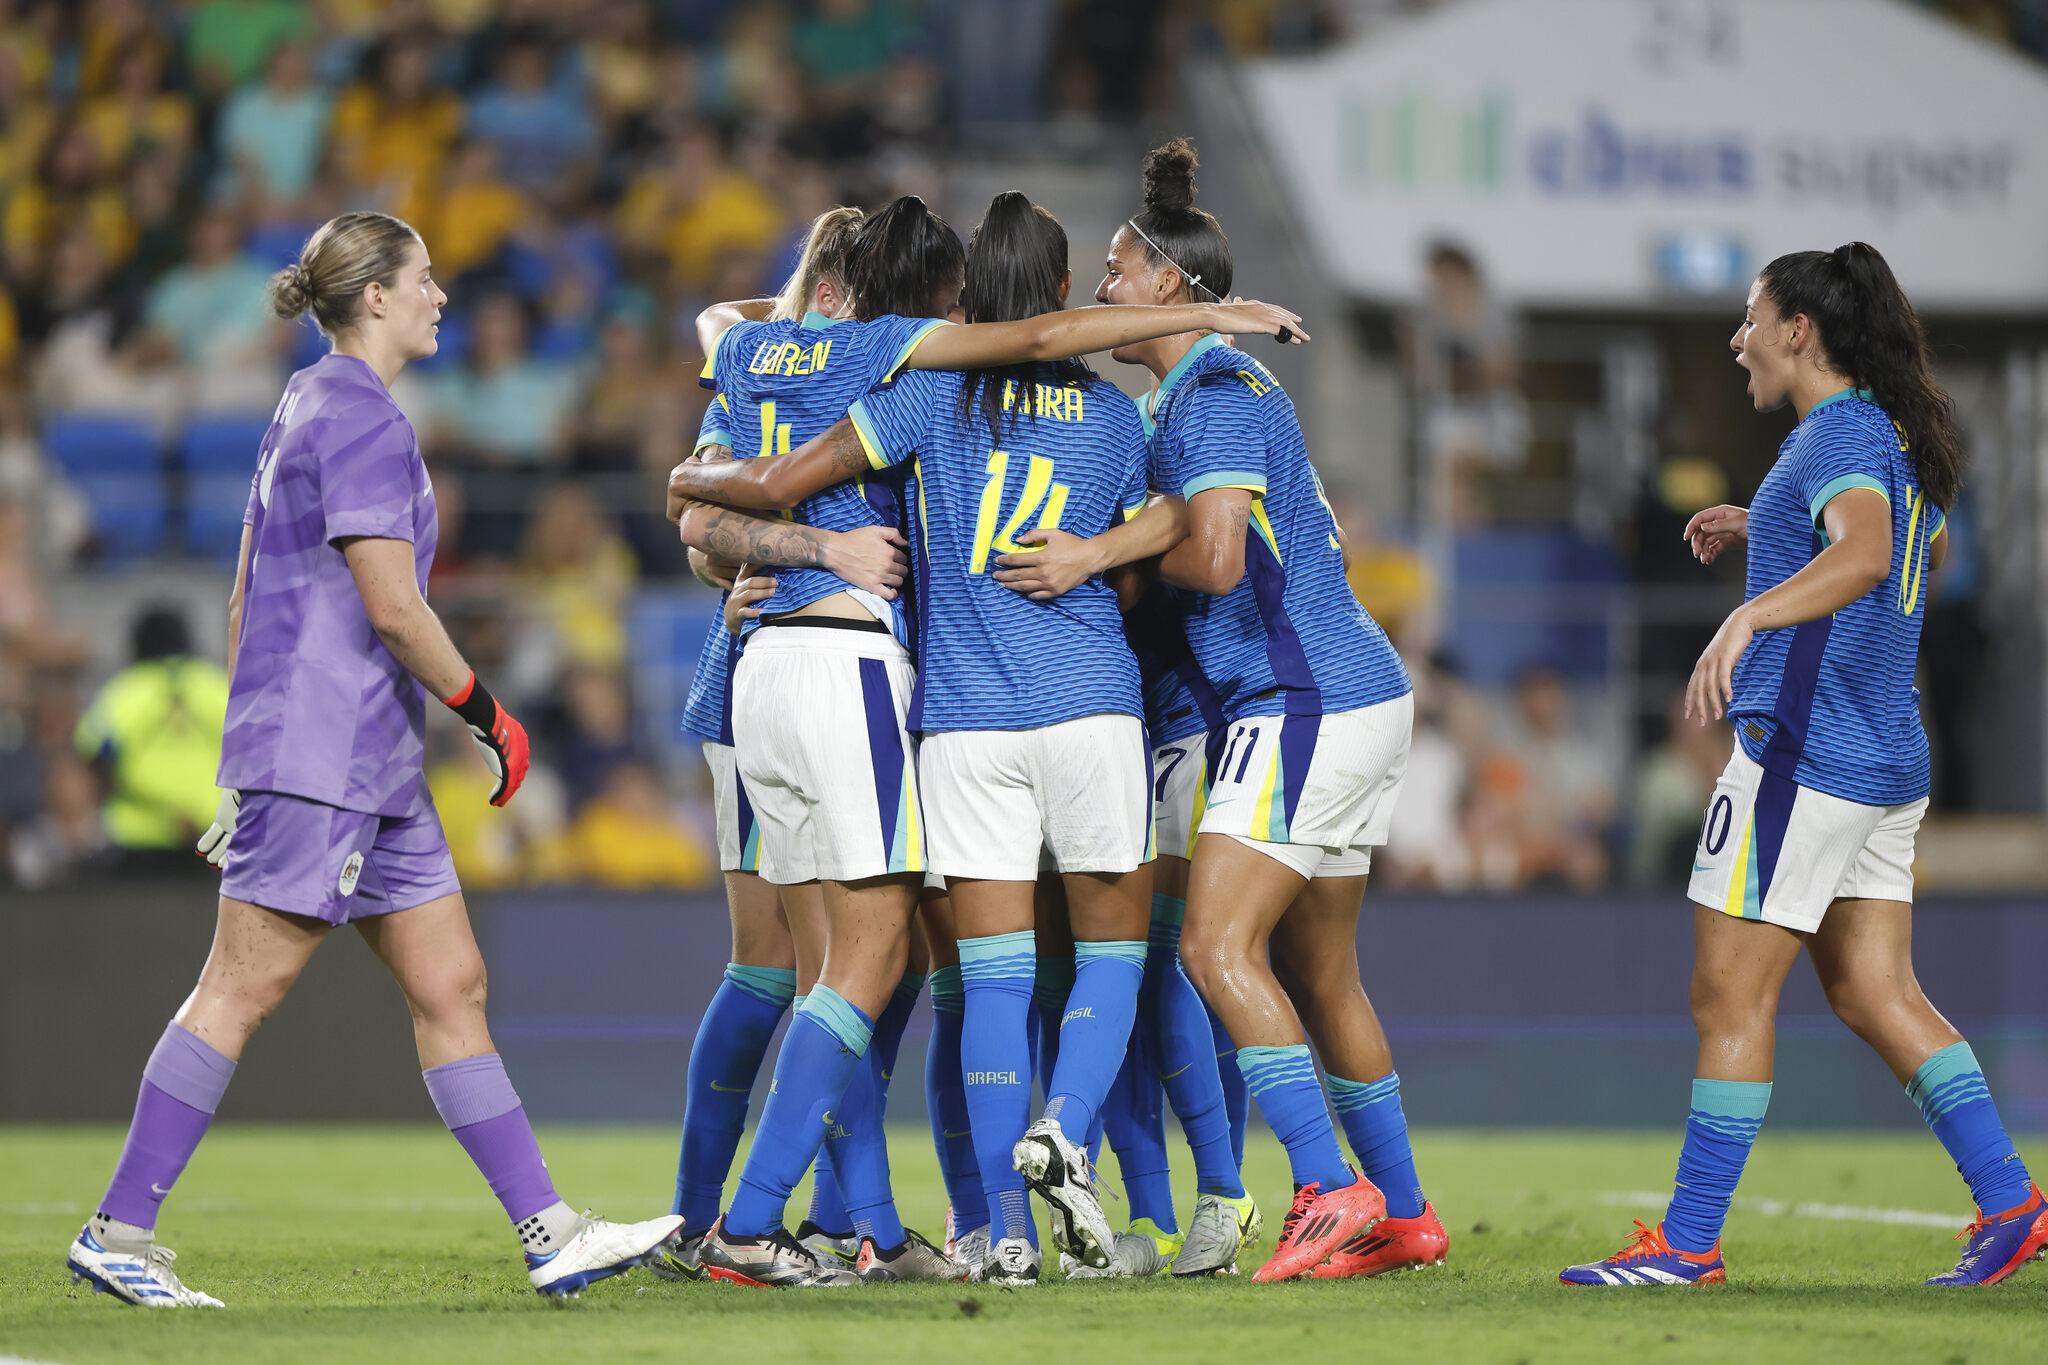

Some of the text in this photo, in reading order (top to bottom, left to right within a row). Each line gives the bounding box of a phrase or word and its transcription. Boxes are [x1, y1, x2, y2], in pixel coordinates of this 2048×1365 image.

[968, 450, 1071, 575] 14
[1219, 727, 1260, 784] 11
[1060, 1007, 1096, 1030] RASIL
[967, 1071, 1022, 1086] BRASIL
[829, 1124, 852, 1140] SIL
